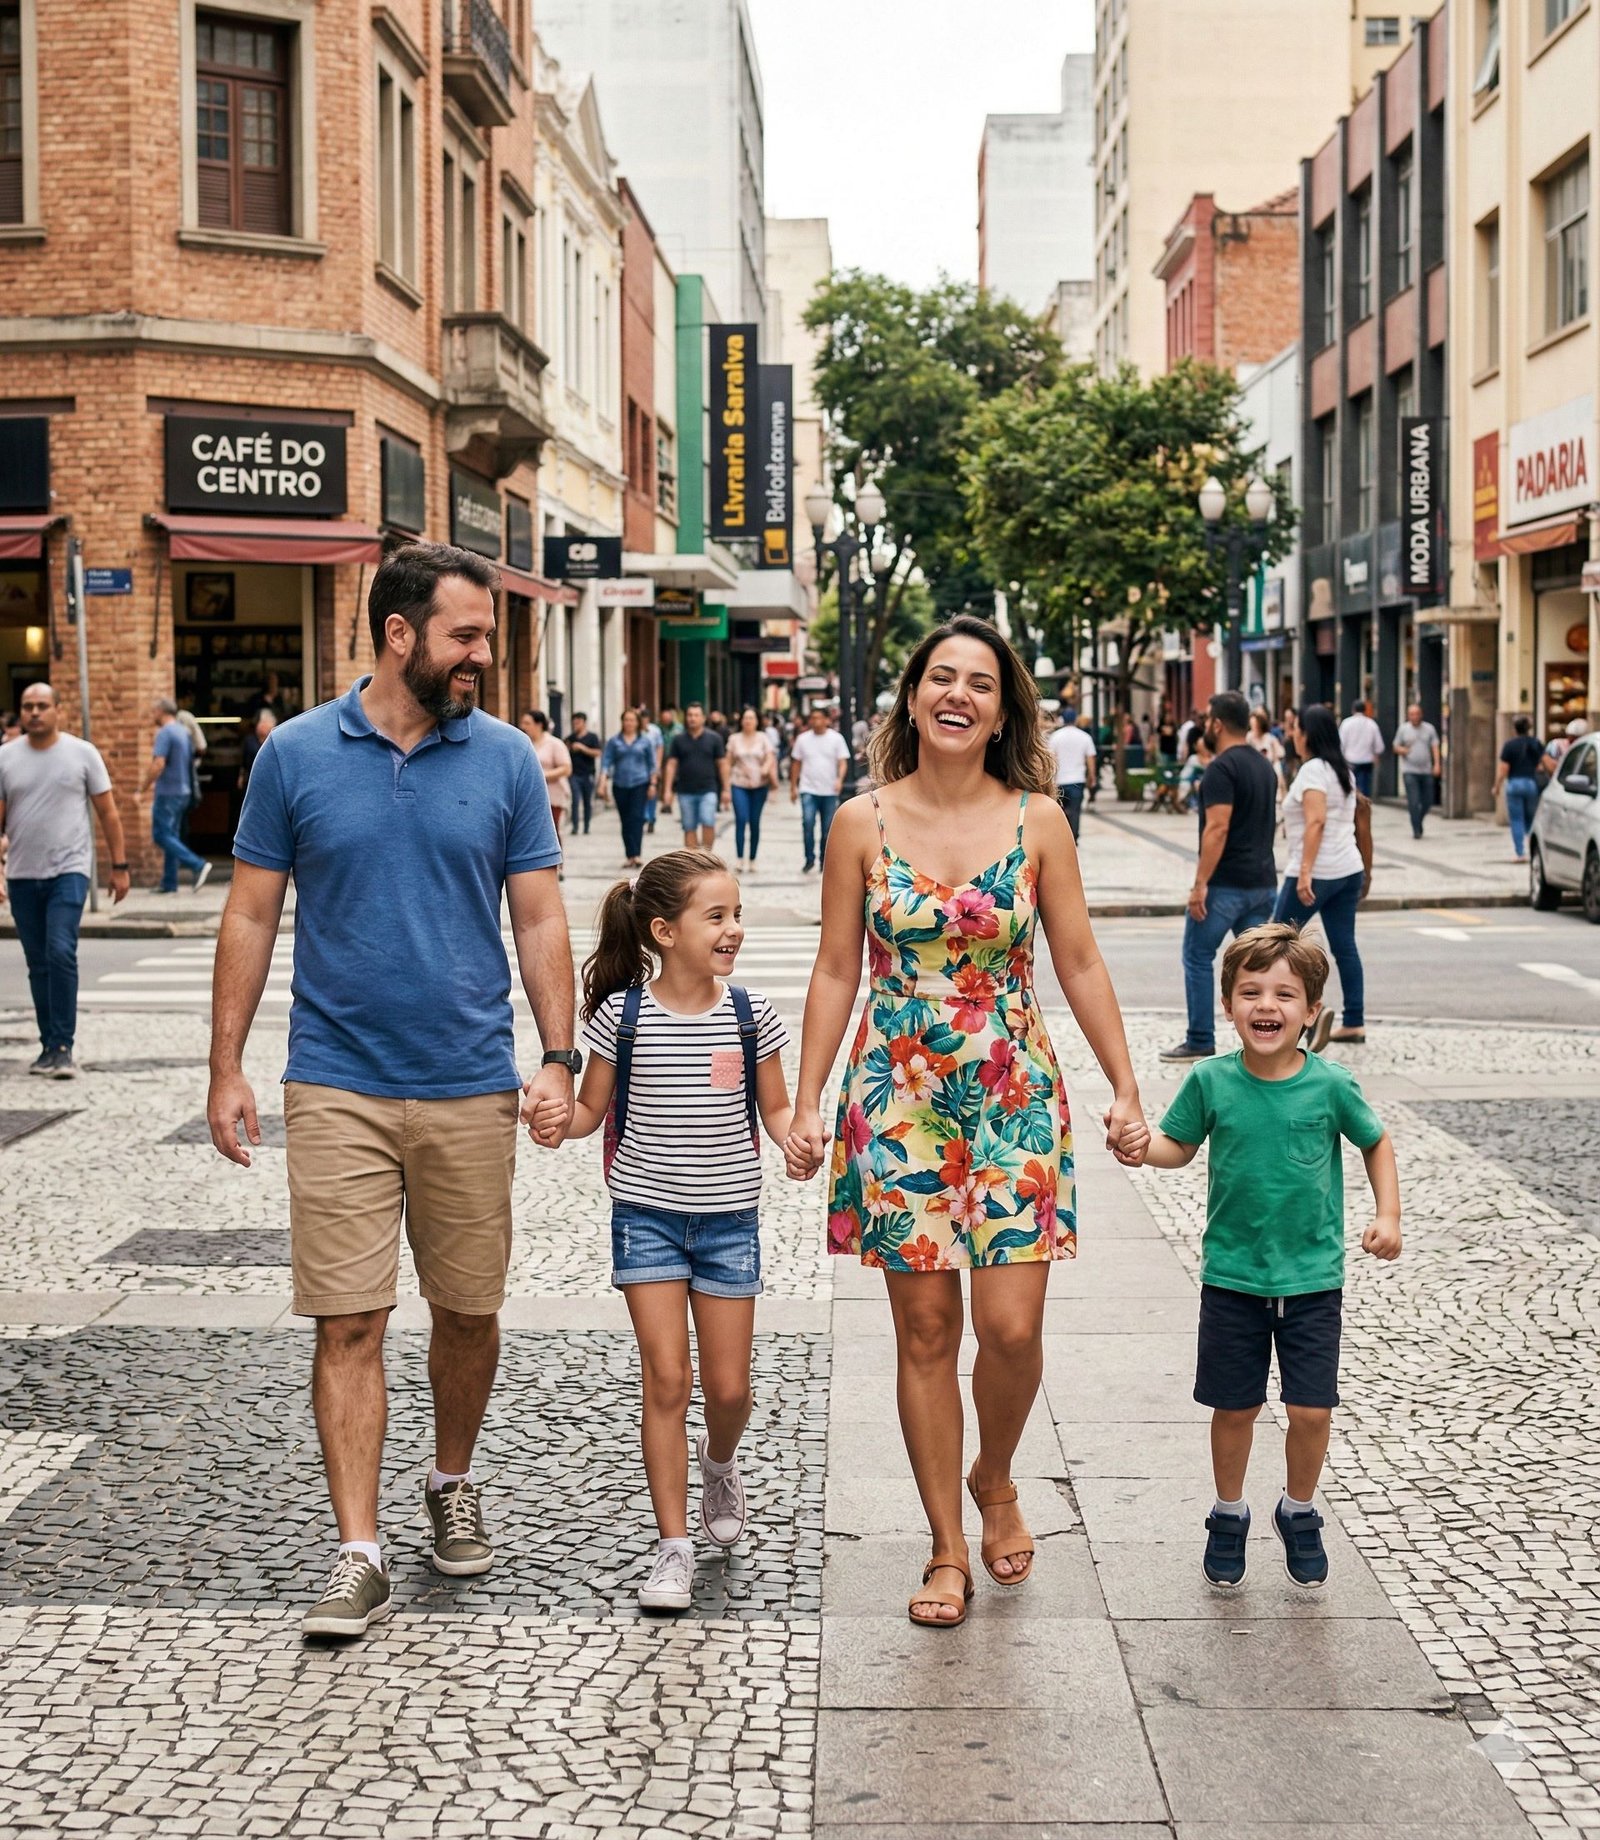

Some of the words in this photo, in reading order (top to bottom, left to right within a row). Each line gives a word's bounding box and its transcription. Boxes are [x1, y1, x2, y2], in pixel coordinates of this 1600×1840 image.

[191, 431, 273, 465] CAFÉ
[281, 439, 326, 466] DO
[1410, 423, 1430, 515] URBANA
[1516, 436, 1588, 503] PADARIA
[197, 466, 322, 498] CENTRO
[1410, 518, 1430, 584] MODA
